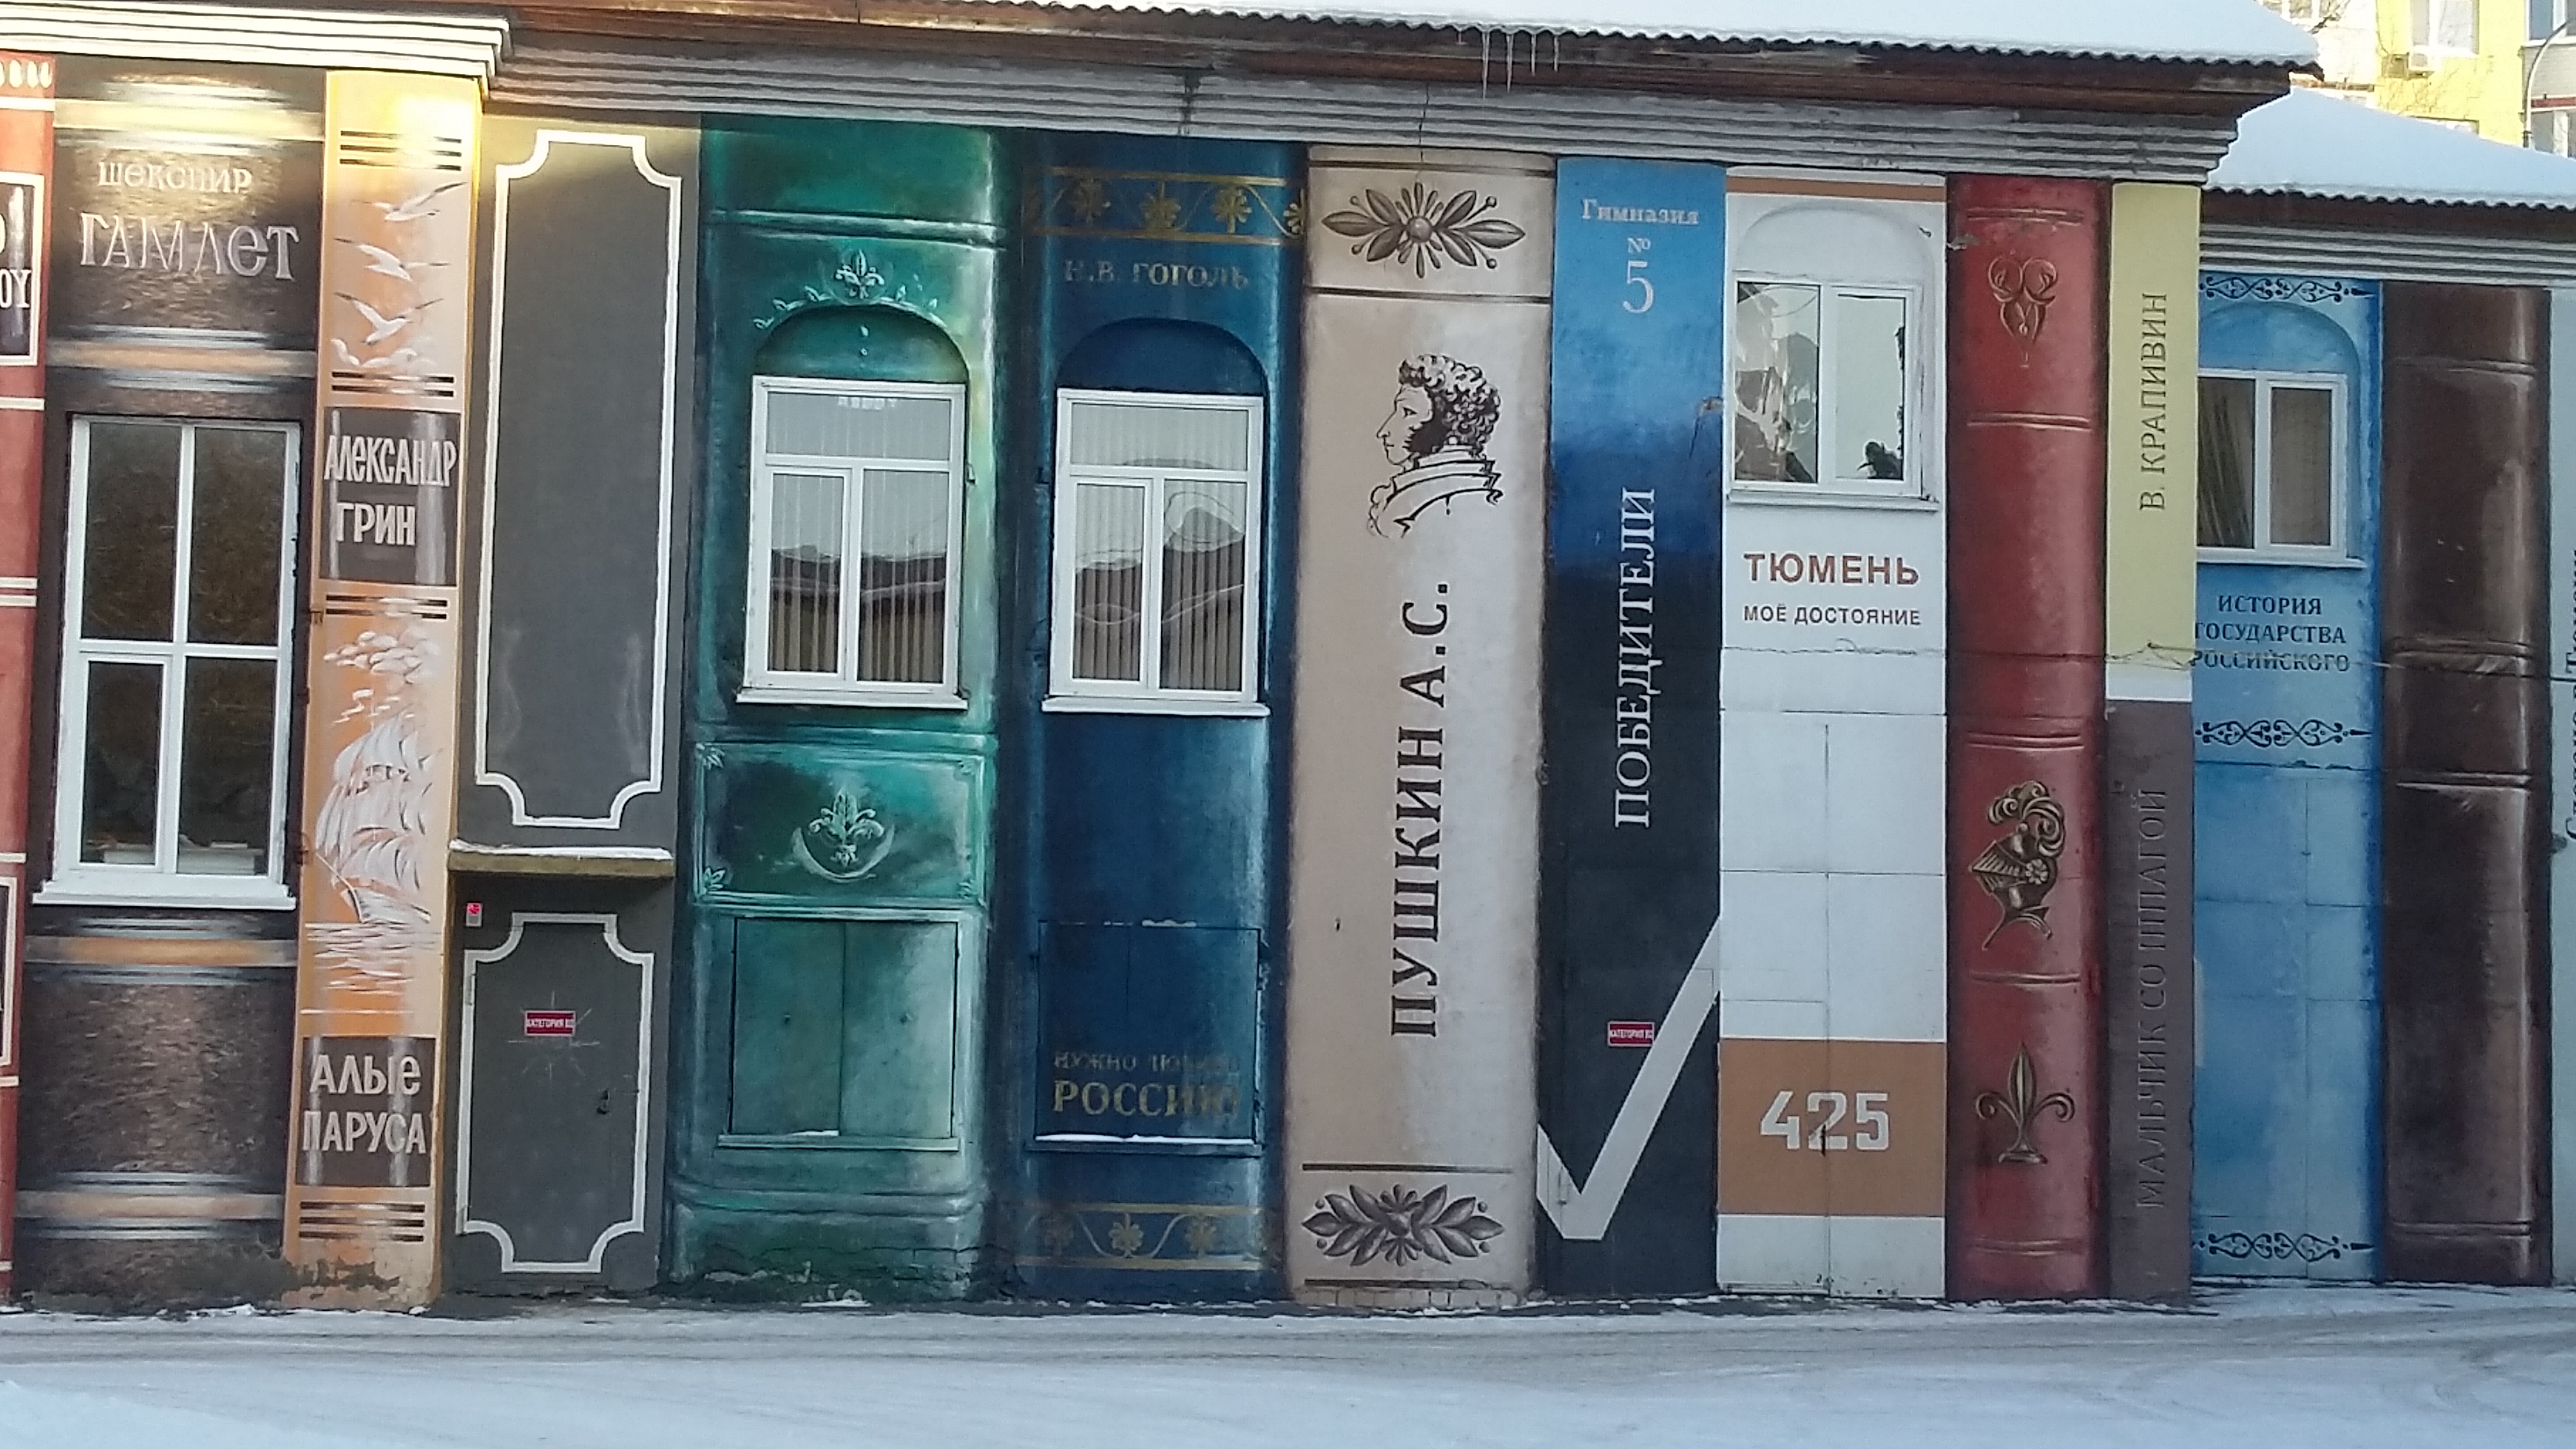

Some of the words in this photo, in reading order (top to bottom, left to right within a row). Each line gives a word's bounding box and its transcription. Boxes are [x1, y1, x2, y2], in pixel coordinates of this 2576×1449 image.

[1582, 198, 1700, 226] Гимназия
[1622, 260, 1654, 314] 5
[2140, 293, 2167, 474] КРАПИВИН
[2140, 486, 2166, 511] В.
[336, 502, 416, 546] ГРИН
[1743, 552, 1920, 586] ТЮМЕНЬ
[1744, 603, 1787, 622] МОЁ
[1794, 606, 1921, 626] ДОСТОЯНИЕ
[2218, 595, 2323, 616] ИСТОРИЯ
[2194, 622, 2347, 645] ГОСУДАРСТВА
[1614, 486, 1664, 829] ПОБЕДИТЕЛИ
[1391, 725, 1445, 1039] ПУШКИН
[2130, 788, 2168, 952] ШПАГОЙ
[2138, 964, 2167, 1011] СО
[302, 1110, 427, 1155] ПАРУСА
[1760, 1090, 1891, 1151] 425
[2136, 1021, 2166, 1209] МАЛЬЧИК
